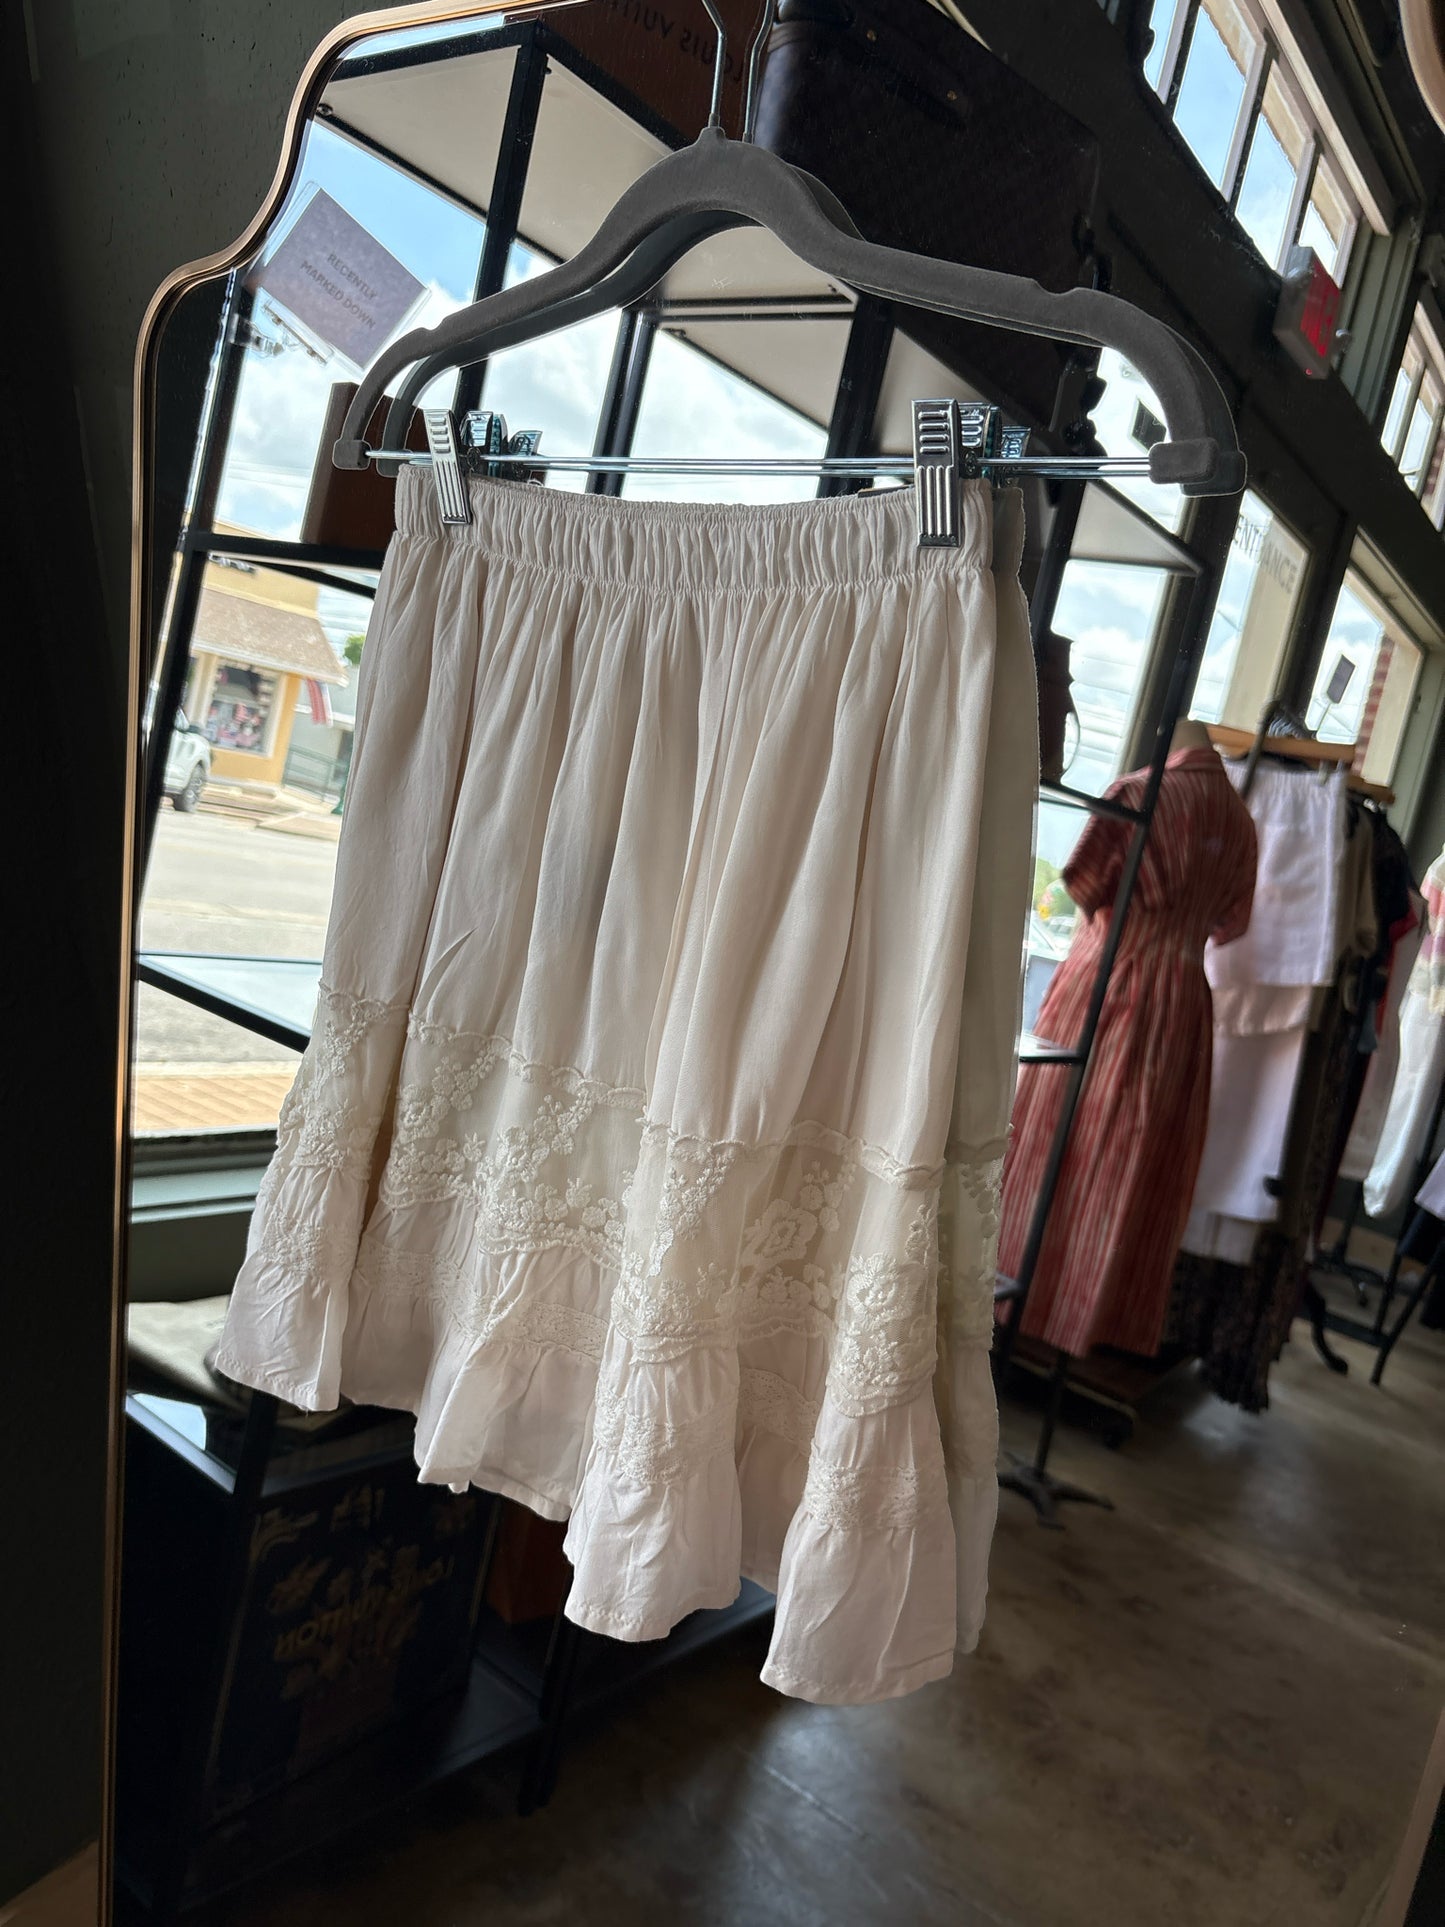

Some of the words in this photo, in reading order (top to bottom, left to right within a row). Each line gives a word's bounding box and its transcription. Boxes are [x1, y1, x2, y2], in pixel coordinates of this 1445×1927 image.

[300, 260, 344, 301] MARKED
[344, 297, 376, 329] DOWN
[326, 251, 378, 300] RECENTLY
